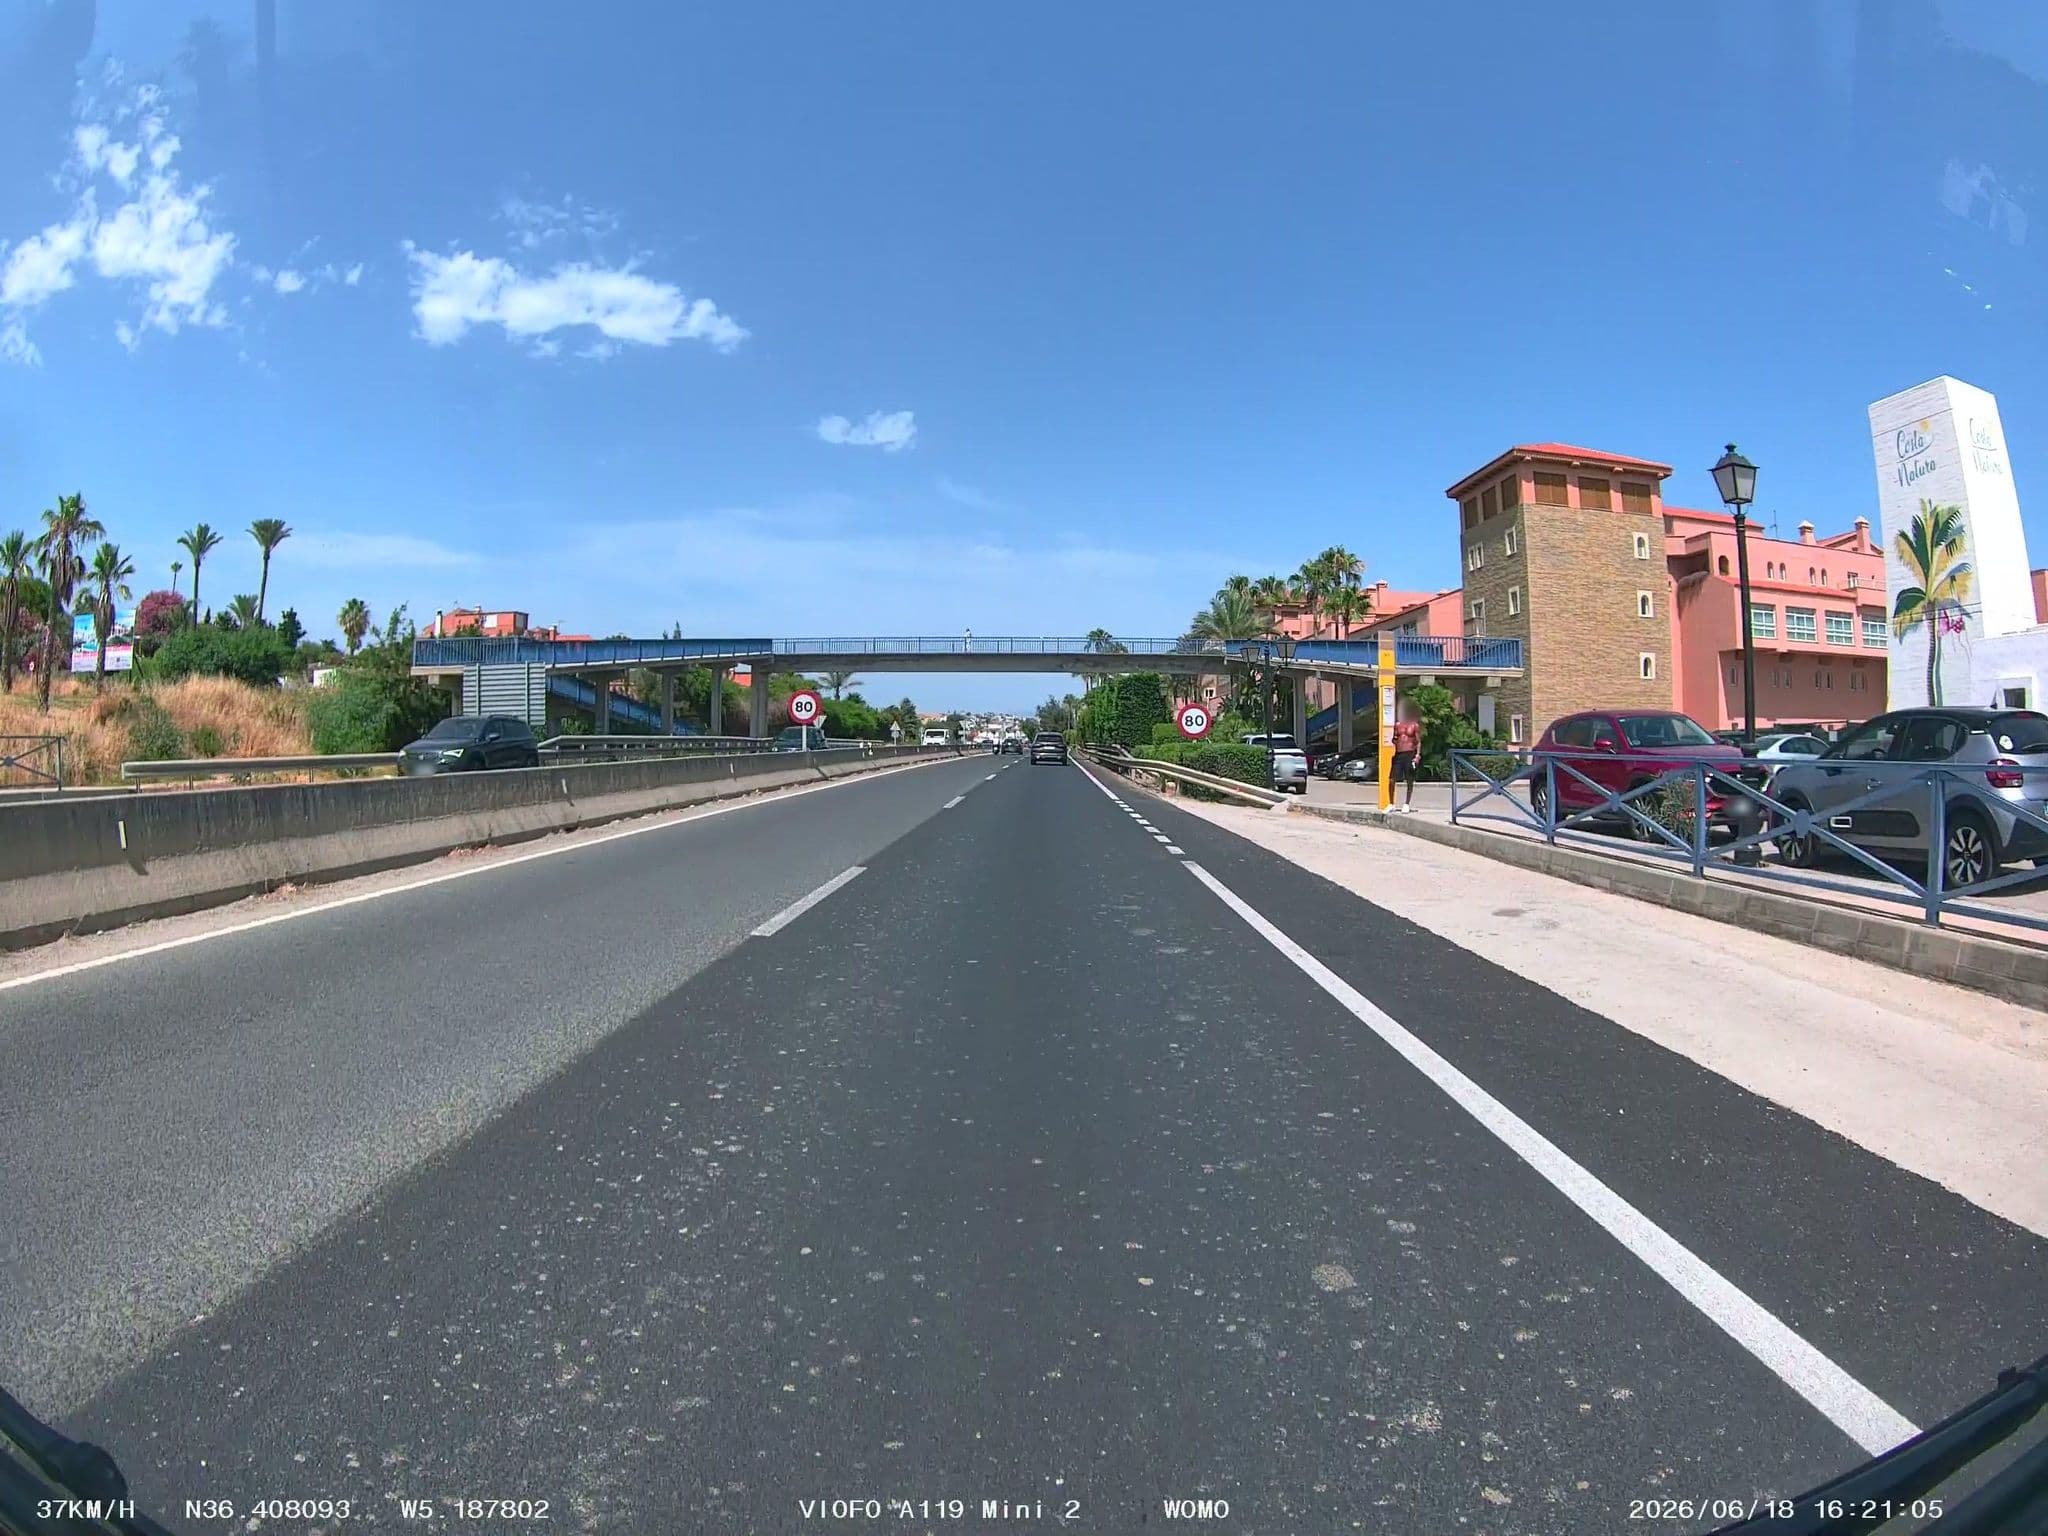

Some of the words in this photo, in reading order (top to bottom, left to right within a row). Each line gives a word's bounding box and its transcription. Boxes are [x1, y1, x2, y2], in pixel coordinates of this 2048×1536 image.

[1897, 459, 1937, 487] Natura
[795, 701, 813, 713] 80
[1184, 715, 1204, 727] 80
